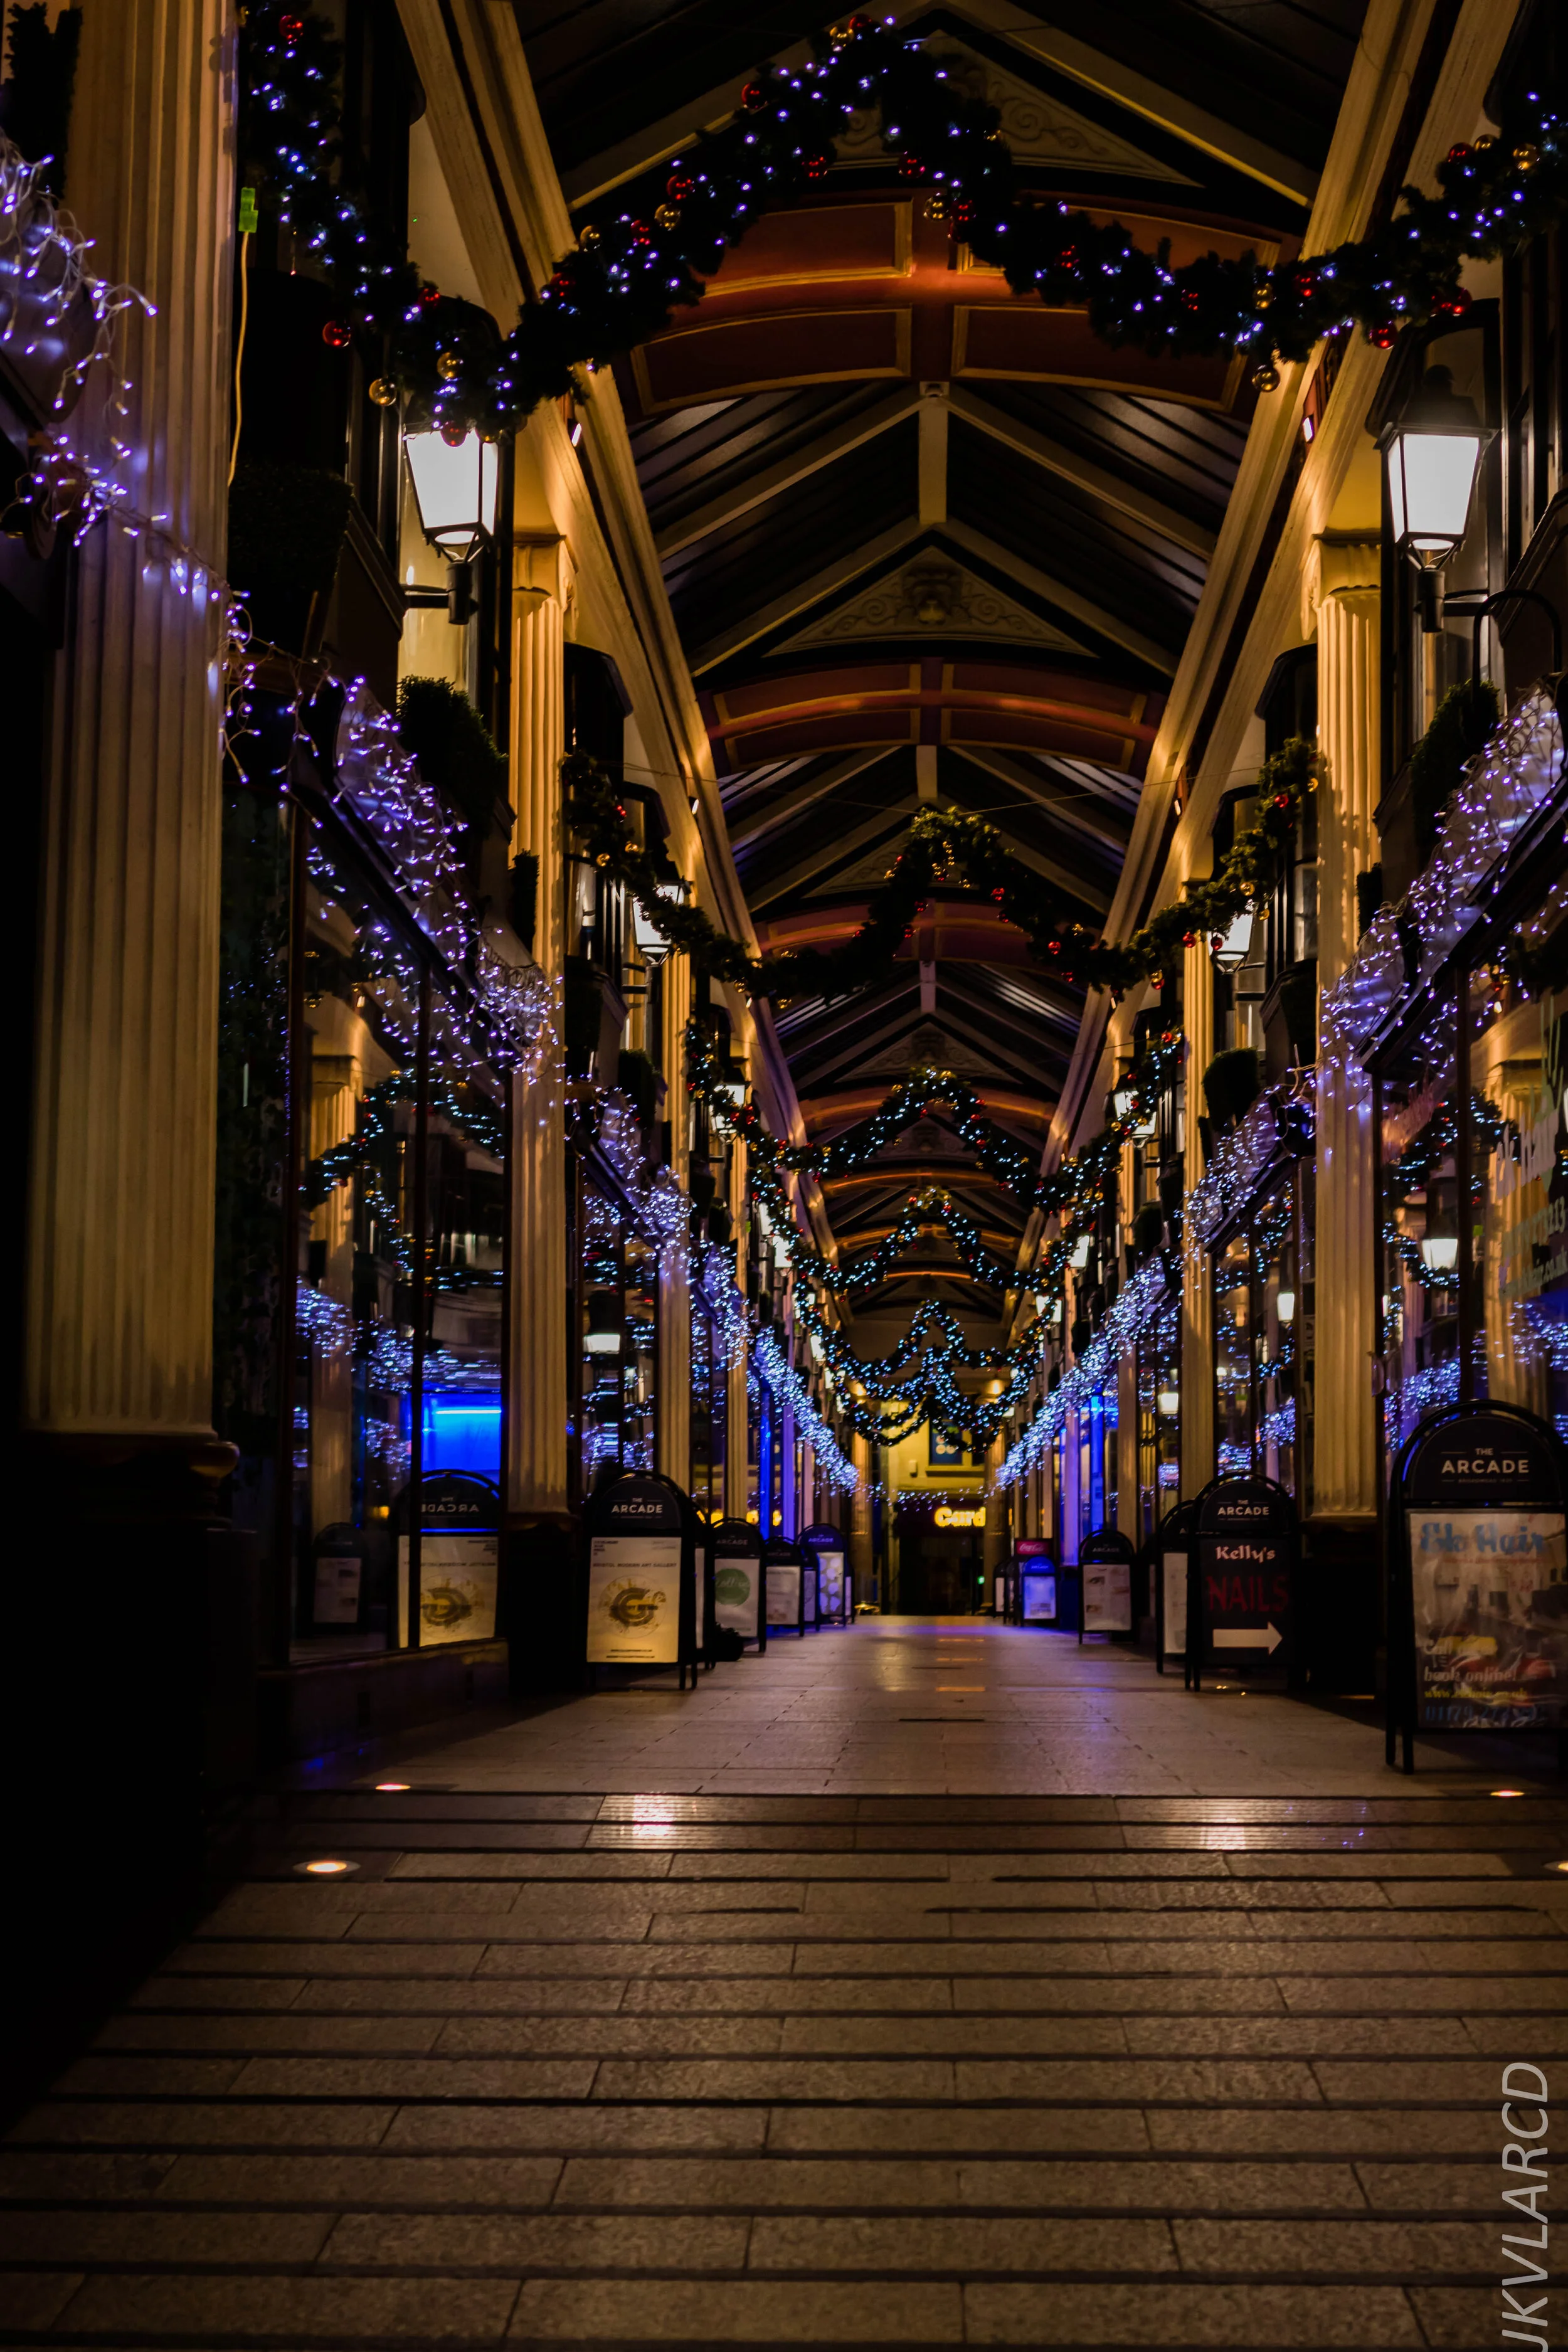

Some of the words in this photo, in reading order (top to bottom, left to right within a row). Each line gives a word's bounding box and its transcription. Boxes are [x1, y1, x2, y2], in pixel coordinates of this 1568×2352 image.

[1441, 1459, 1530, 1474] ARCADE
[612, 1505, 662, 1513] ARCADE
[935, 1507, 986, 1527] Card
[1217, 1507, 1269, 1515] ARCADE
[1215, 1545, 1276, 1564] Kelly's
[1205, 1575, 1290, 1612] NAILS
[1424, 1665, 1460, 1682] book
